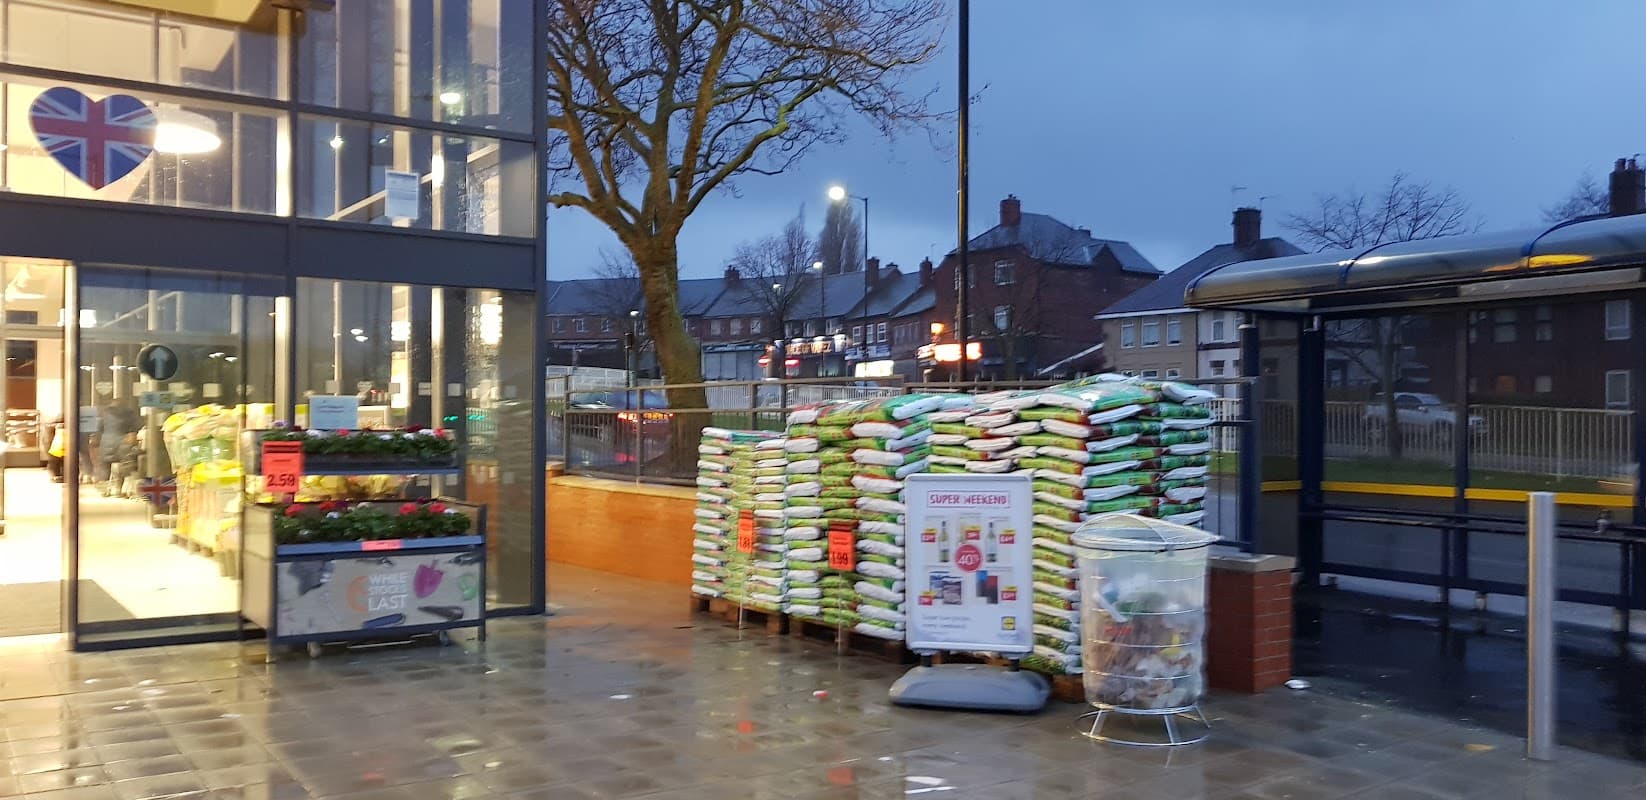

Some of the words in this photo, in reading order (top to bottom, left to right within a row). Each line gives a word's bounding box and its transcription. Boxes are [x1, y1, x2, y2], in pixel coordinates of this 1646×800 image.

[267, 474, 295, 487] 2.59
[930, 494, 960, 504] SUPER
[964, 495, 1007, 505] WEEKEND
[368, 571, 408, 585] WHILE
[368, 594, 408, 611] LAST
